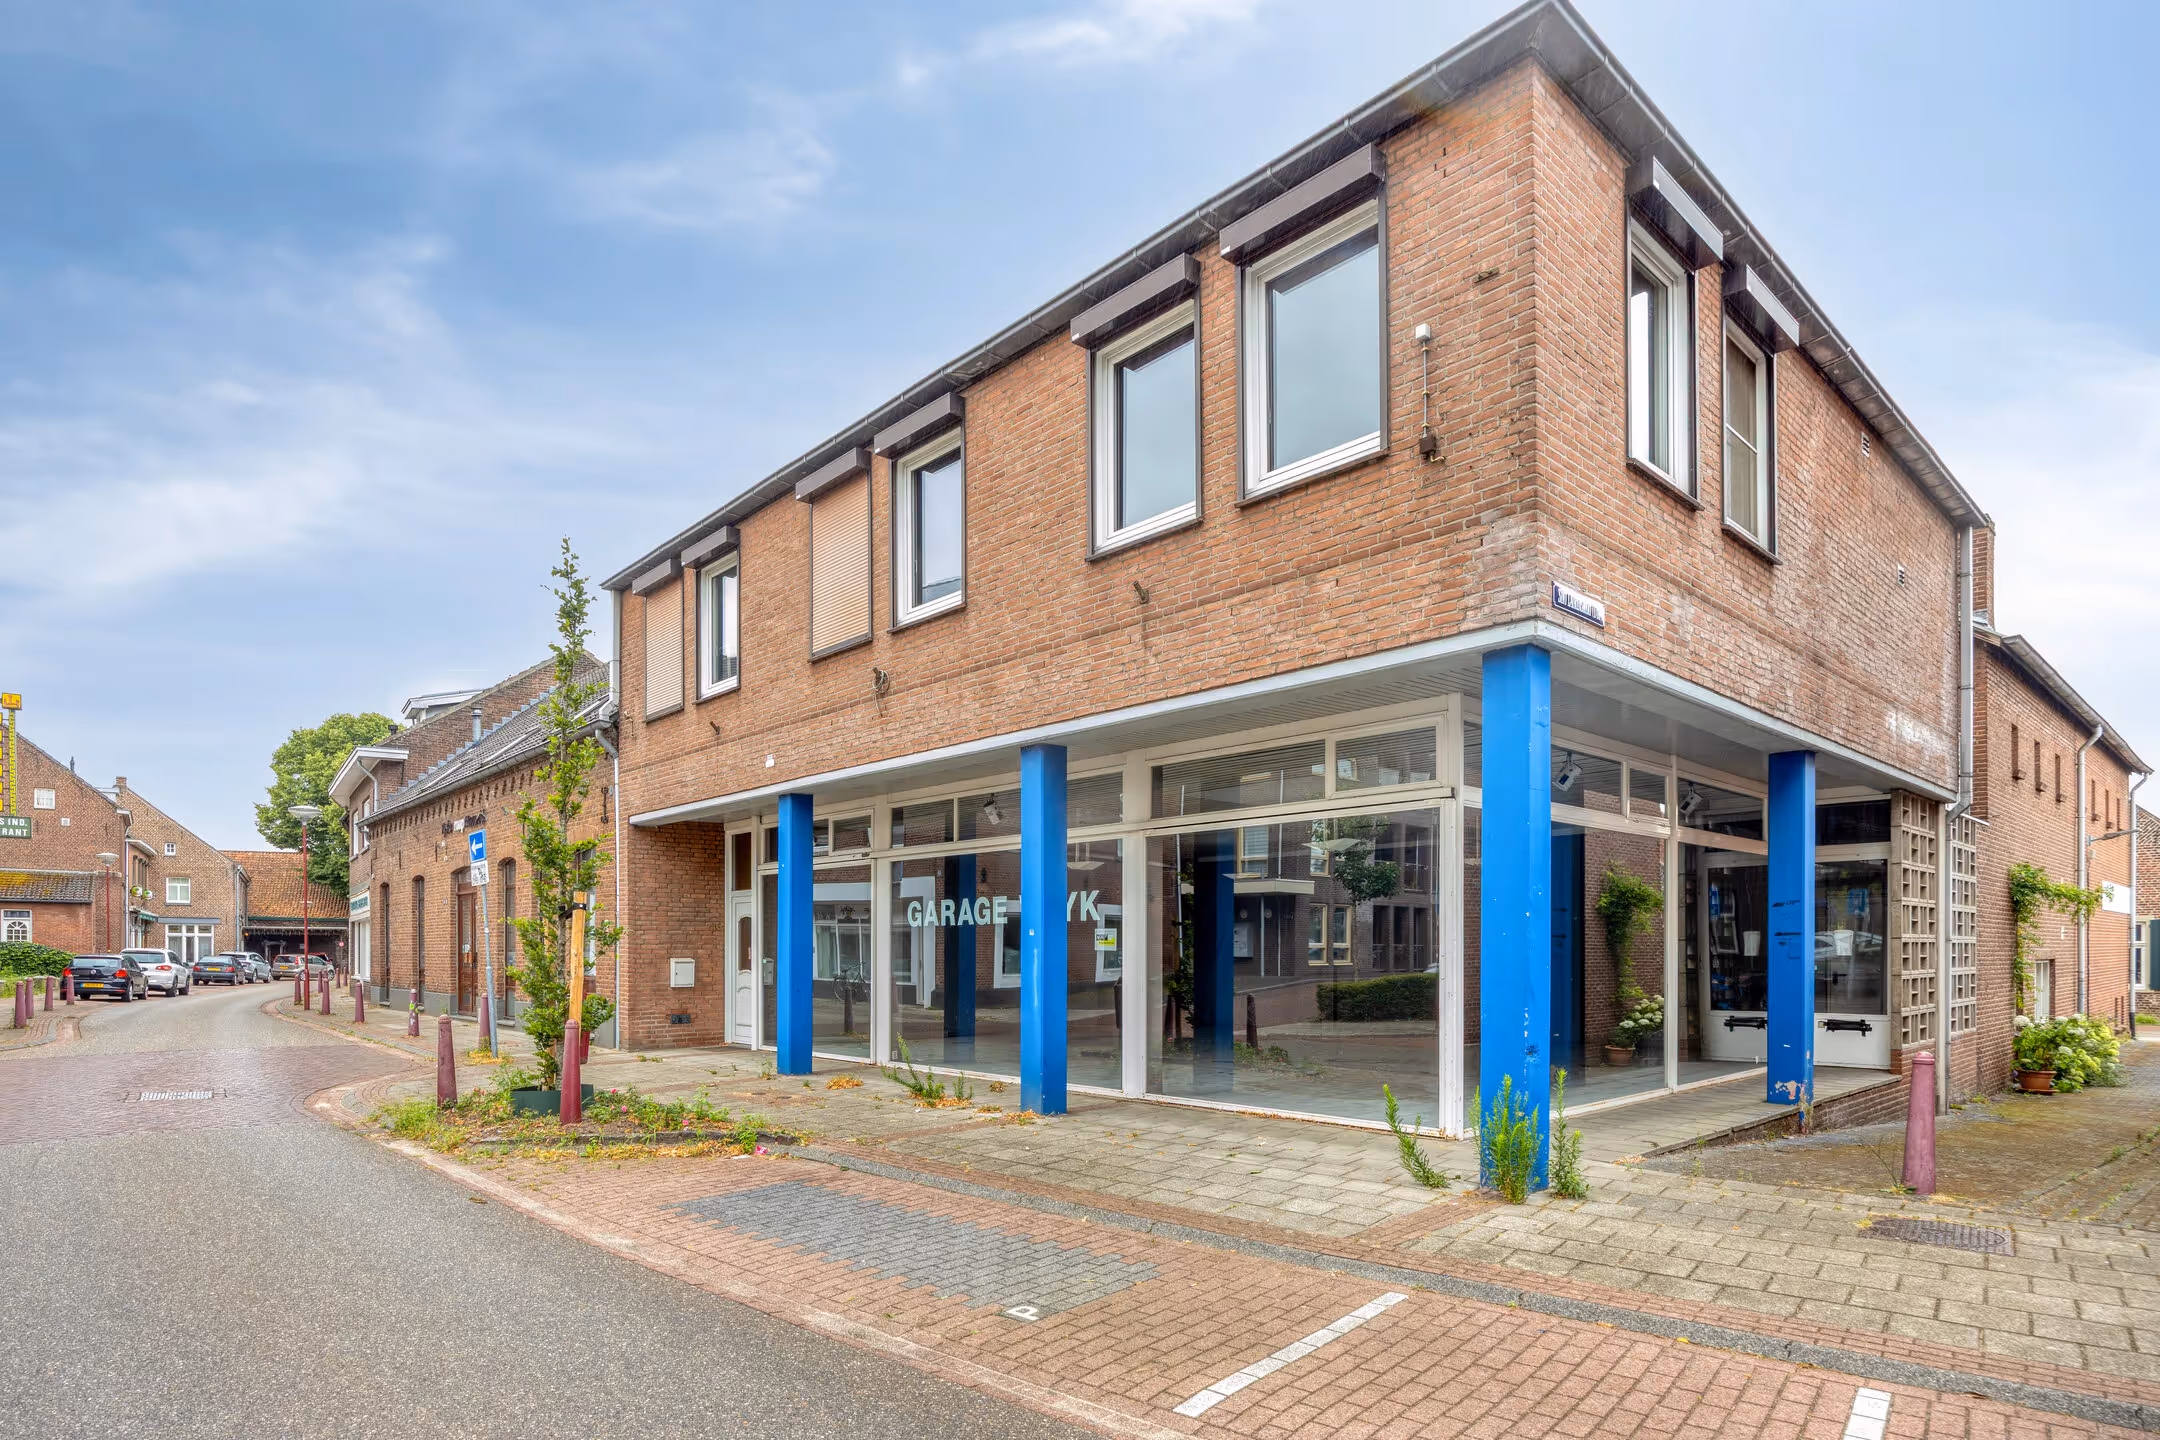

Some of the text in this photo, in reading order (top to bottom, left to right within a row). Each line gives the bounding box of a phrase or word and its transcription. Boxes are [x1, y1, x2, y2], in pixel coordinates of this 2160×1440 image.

[8, 818, 28, 827] IND.
[2, 828, 28, 837] RANT
[907, 895, 1008, 928] GARAGE
[1006, 1305, 1040, 1321] P
